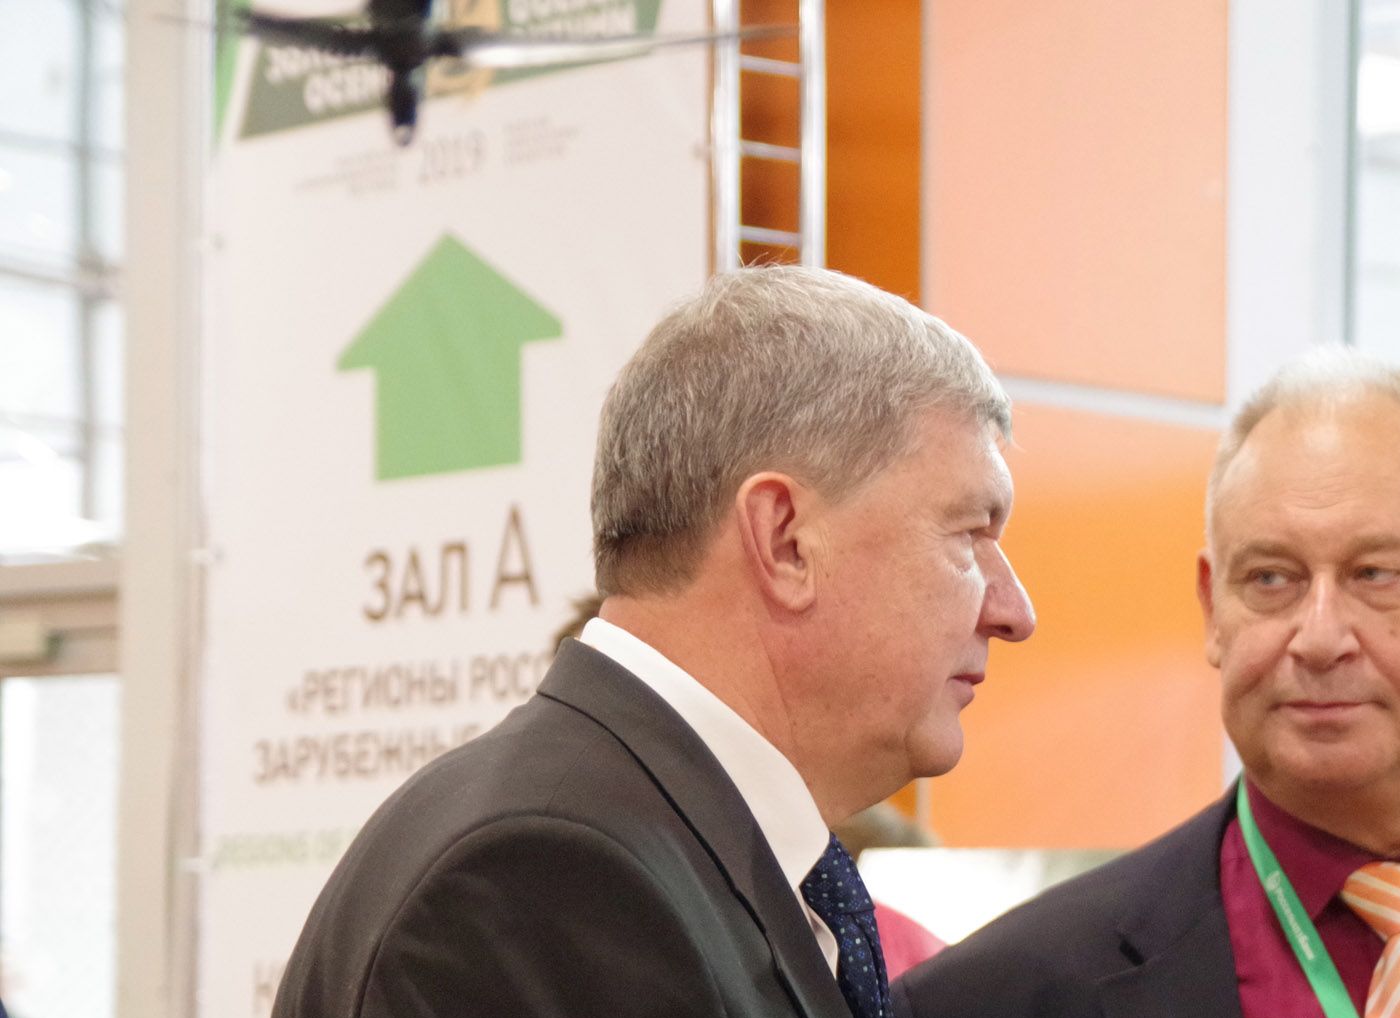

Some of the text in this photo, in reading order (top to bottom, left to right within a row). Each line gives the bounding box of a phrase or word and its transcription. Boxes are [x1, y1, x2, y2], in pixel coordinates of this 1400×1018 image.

[362, 502, 541, 622] ЗАЛ А
[469, 650, 557, 702] РОСС
